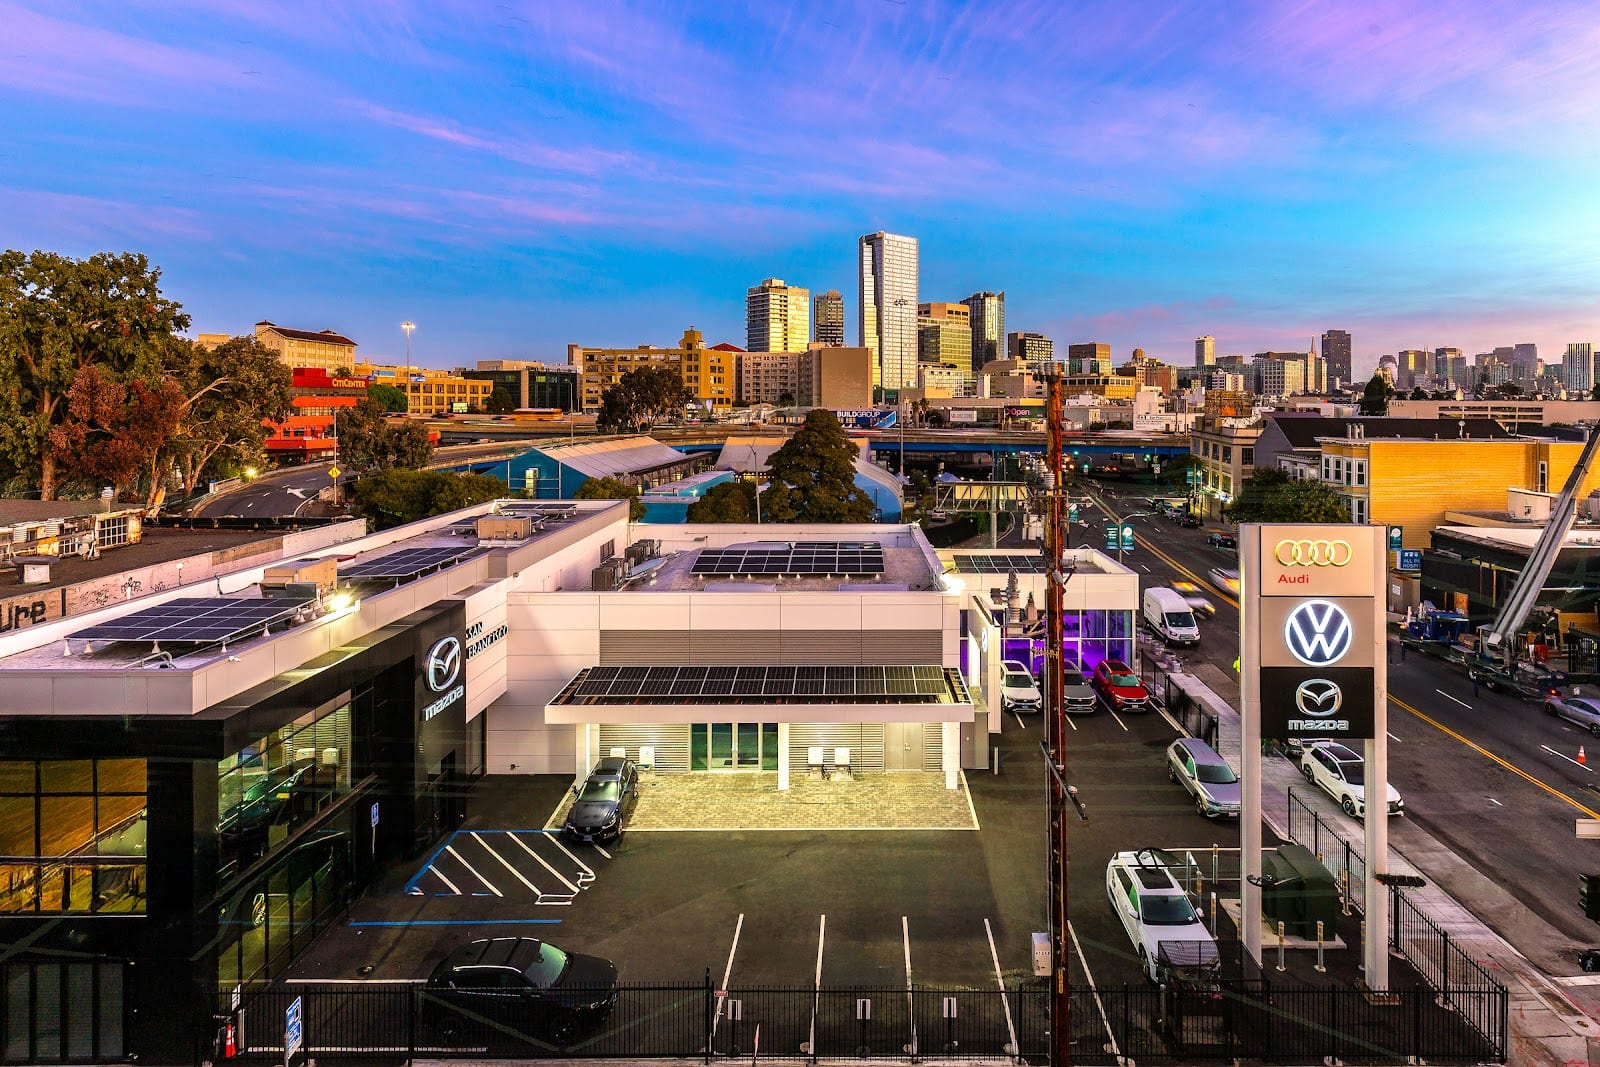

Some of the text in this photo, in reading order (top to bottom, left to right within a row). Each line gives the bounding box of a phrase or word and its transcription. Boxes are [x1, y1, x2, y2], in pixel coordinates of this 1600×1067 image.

[1011, 408, 1030, 416] Open
[1278, 574, 1310, 584] Audi
[467, 622, 483, 639] SAN
[467, 625, 508, 659] FRANCISCO
